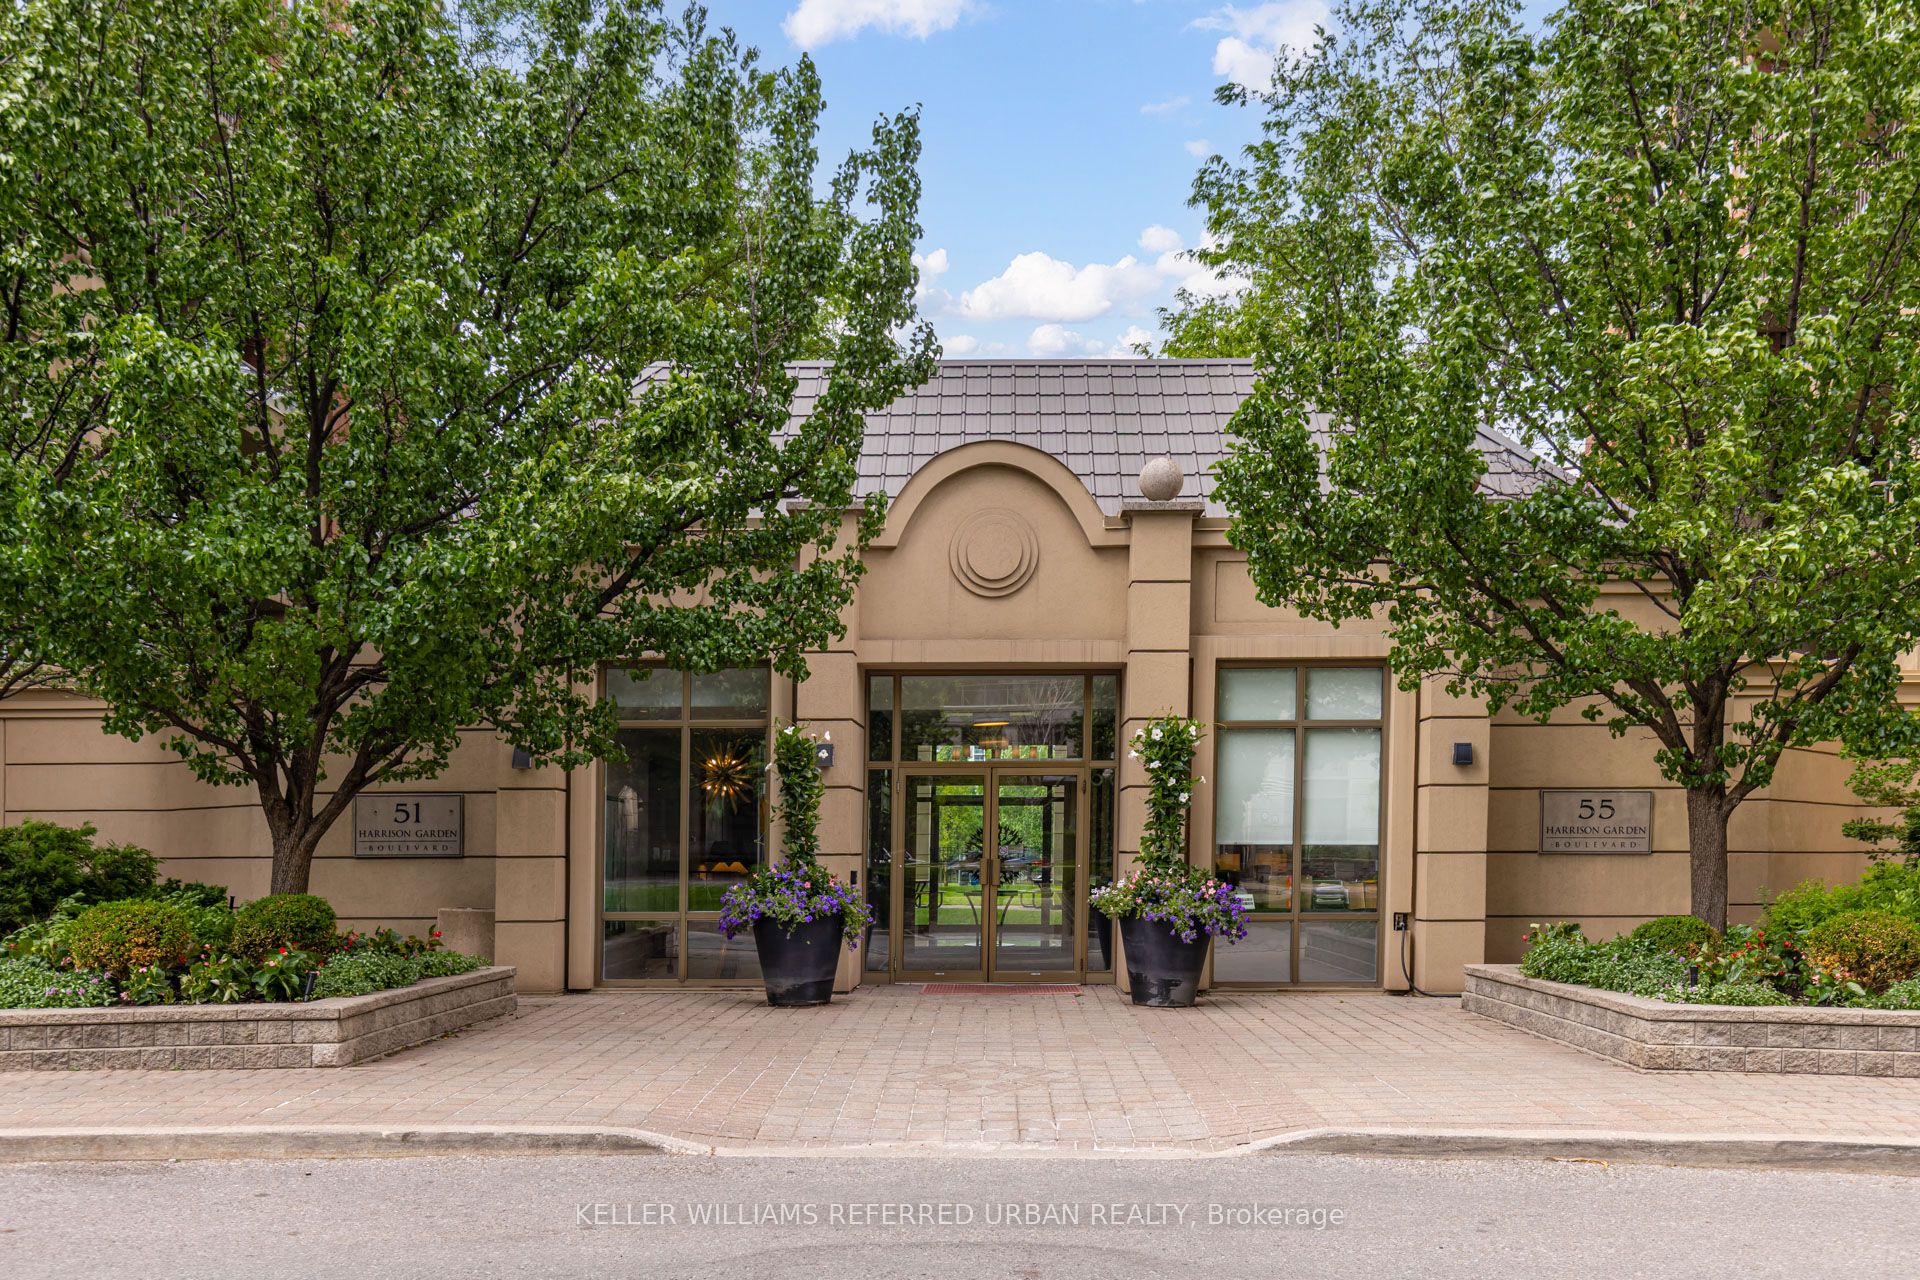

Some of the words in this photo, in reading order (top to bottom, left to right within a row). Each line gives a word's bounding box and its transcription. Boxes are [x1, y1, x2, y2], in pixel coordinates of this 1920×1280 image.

[394, 803, 421, 824] 51
[1578, 799, 1616, 820] 55
[359, 830, 411, 838] HARRISON
[415, 830, 458, 838] GARDEN
[1546, 826, 1600, 835] HARRISON
[1603, 826, 1647, 835] GARDEN
[1555, 841, 1637, 849] BOULEVARD
